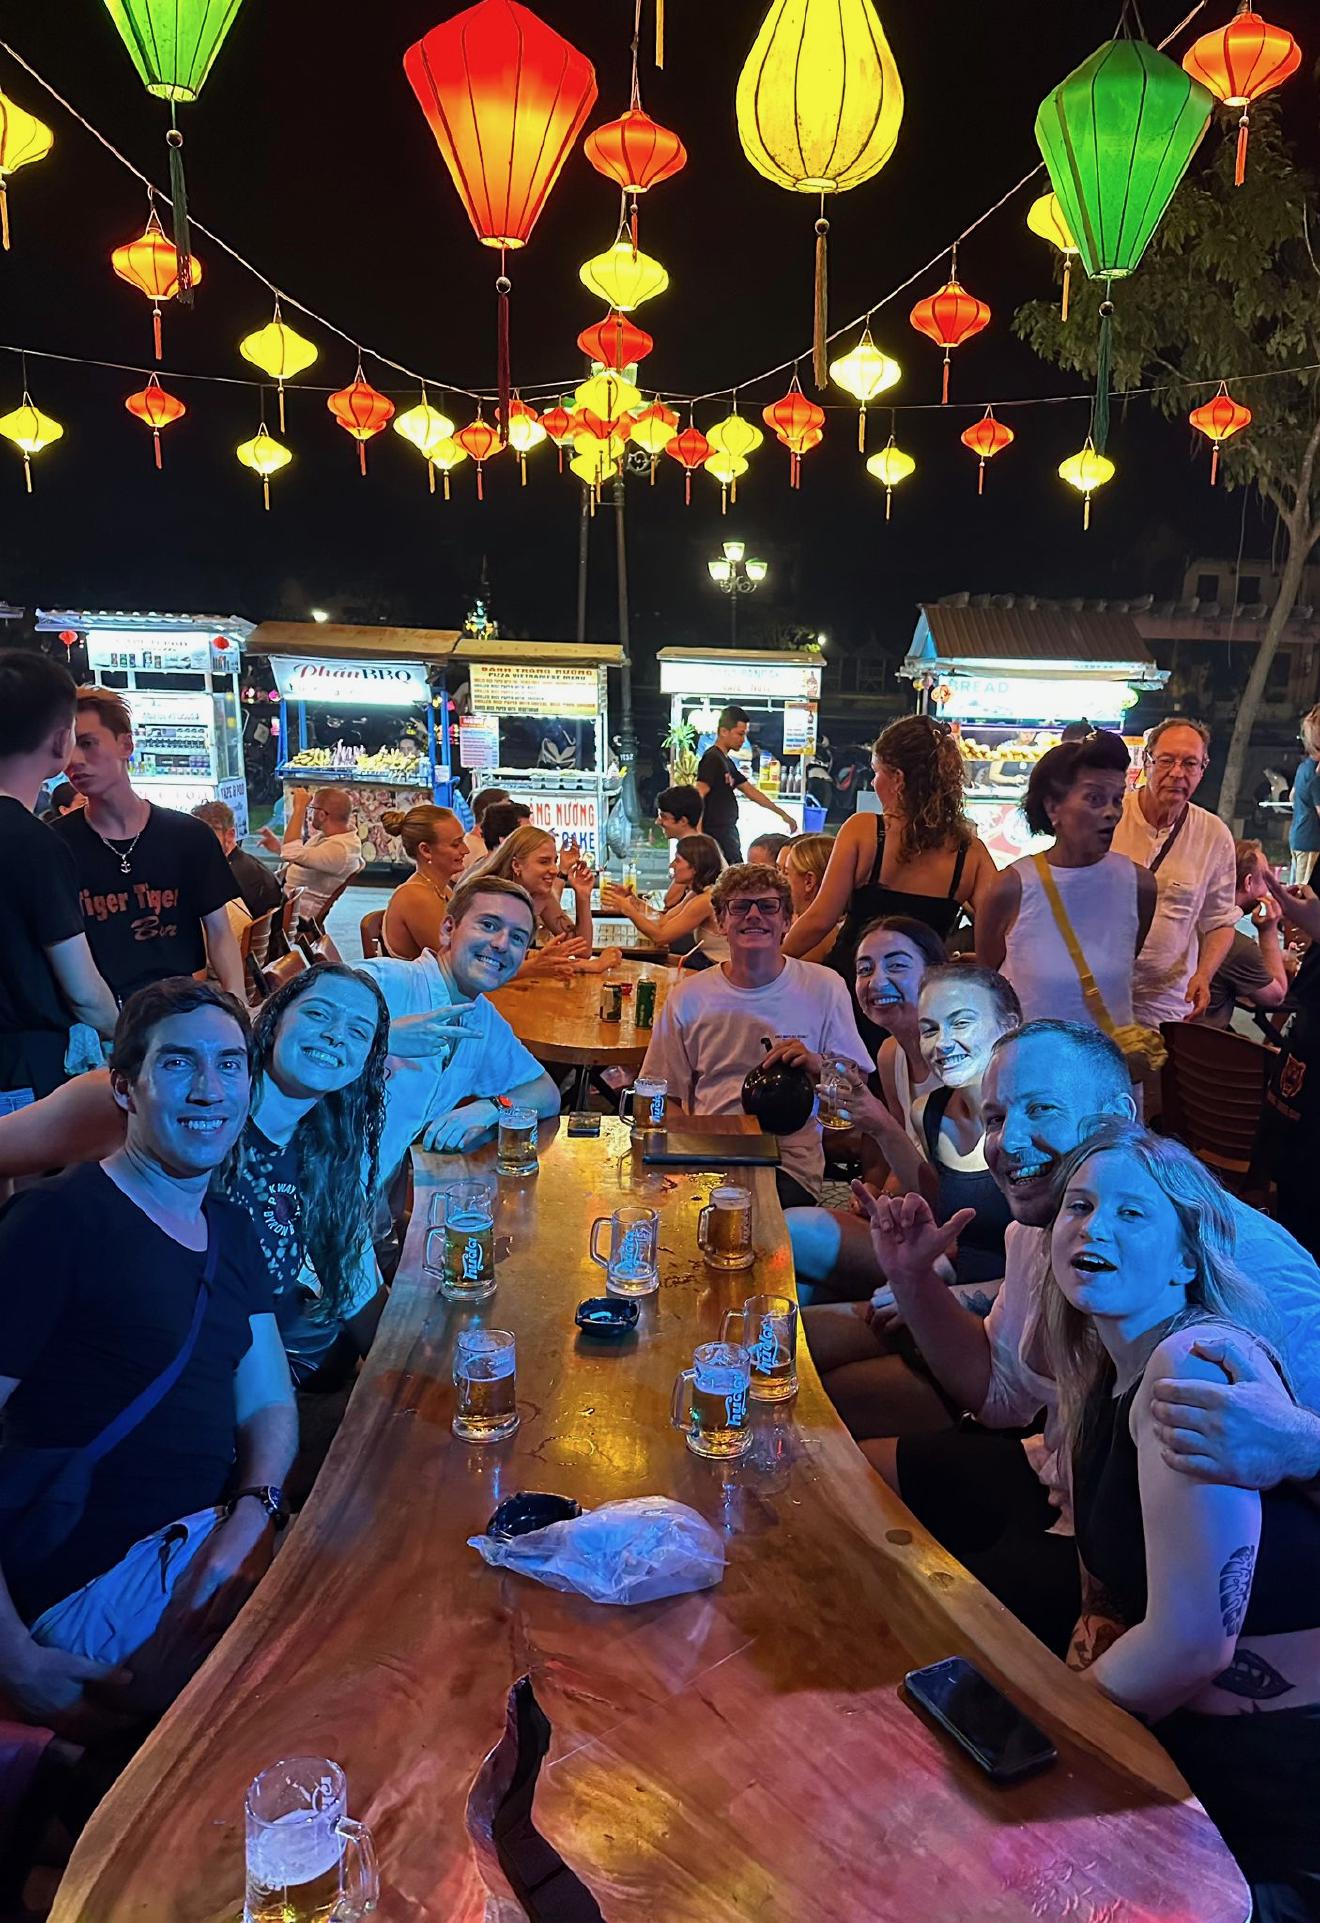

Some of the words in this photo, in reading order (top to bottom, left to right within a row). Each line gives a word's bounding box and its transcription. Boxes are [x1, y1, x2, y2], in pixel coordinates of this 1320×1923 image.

[462, 1237, 484, 1280] huda
[755, 1322, 779, 1376] huda
[725, 1374, 747, 1428] huda
